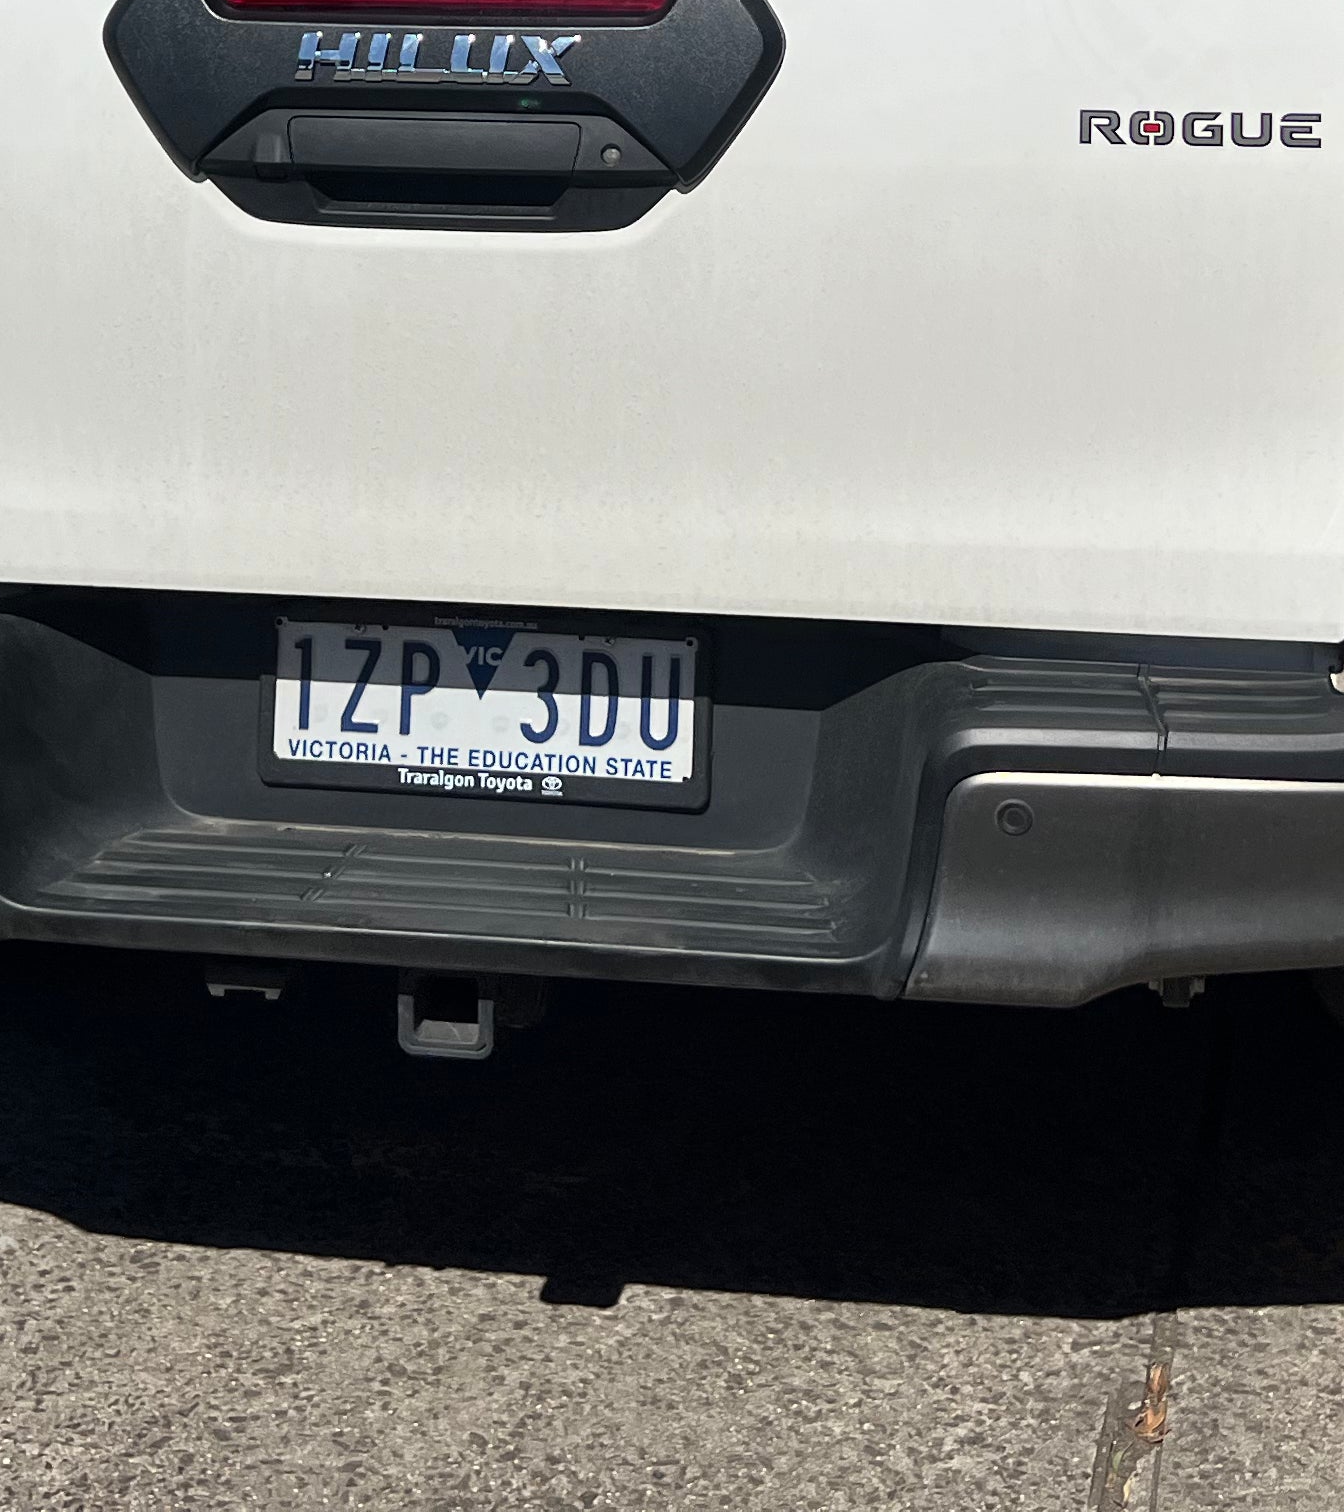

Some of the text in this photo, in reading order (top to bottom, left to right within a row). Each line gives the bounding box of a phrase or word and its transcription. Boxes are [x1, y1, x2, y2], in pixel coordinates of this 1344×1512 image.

[294, 31, 582, 86] HILUX
[1079, 109, 1321, 148] ROGUE
[458, 644, 504, 667] VIC
[294, 636, 681, 751] 1ZP 3DU
[288, 738, 391, 764] VICTORIA
[417, 746, 458, 767] THE
[469, 749, 596, 775] EDUCATION
[605, 757, 673, 780] STATE
[398, 767, 533, 794] Traralgon Toyota
